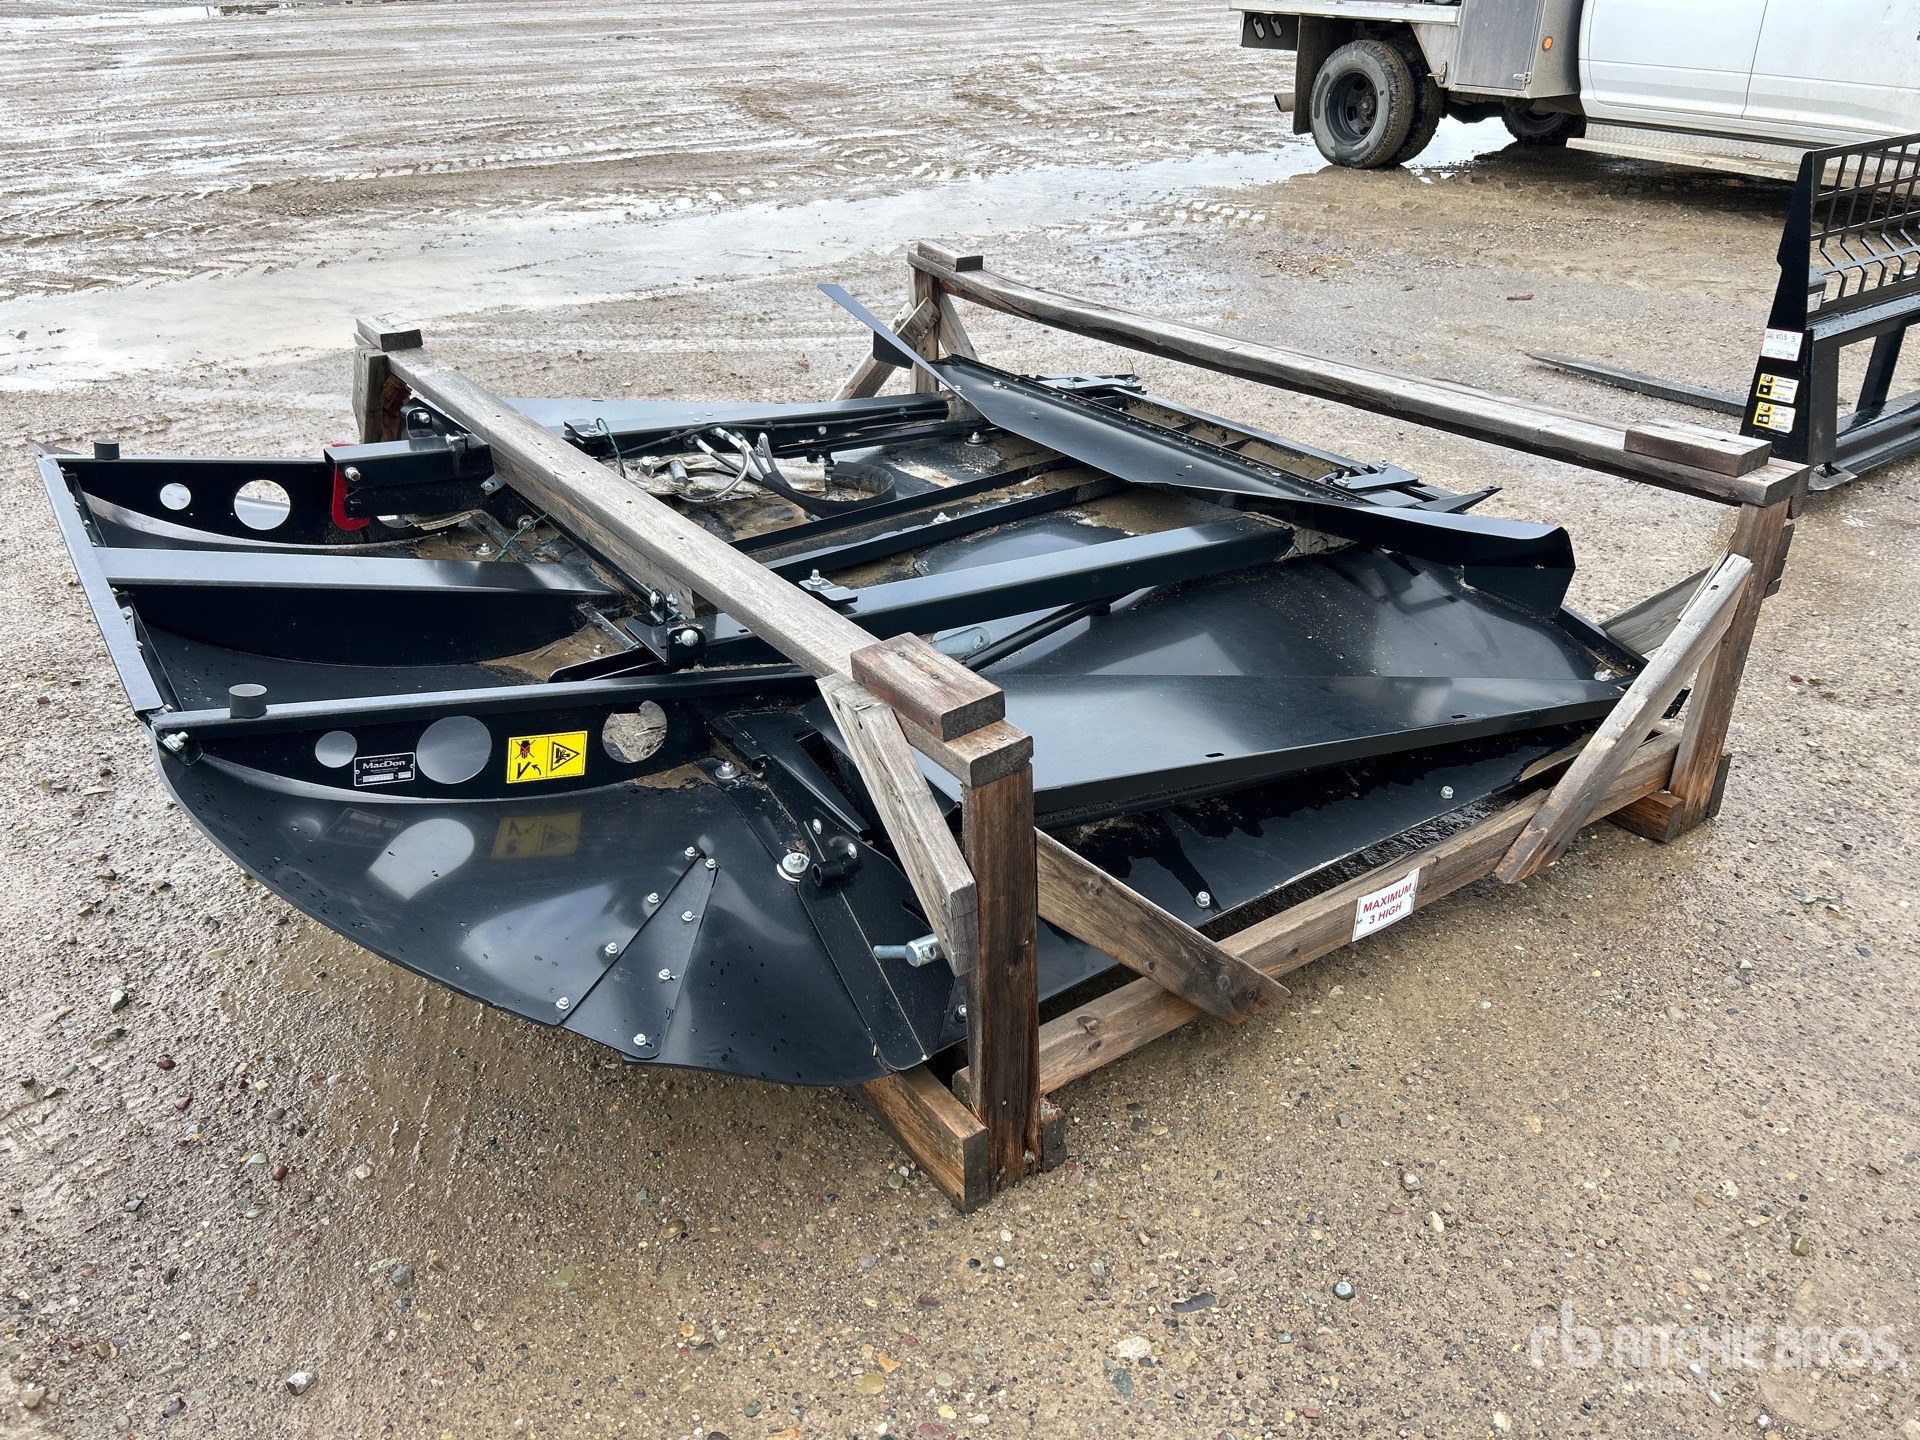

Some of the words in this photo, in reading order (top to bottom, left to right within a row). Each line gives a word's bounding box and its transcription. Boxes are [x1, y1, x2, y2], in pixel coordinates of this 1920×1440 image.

[362, 760, 406, 770] MacDon
[1363, 883, 1412, 914] MAXIMUM
[1369, 915, 1375, 924] 3
[1378, 901, 1402, 921] HIGH
